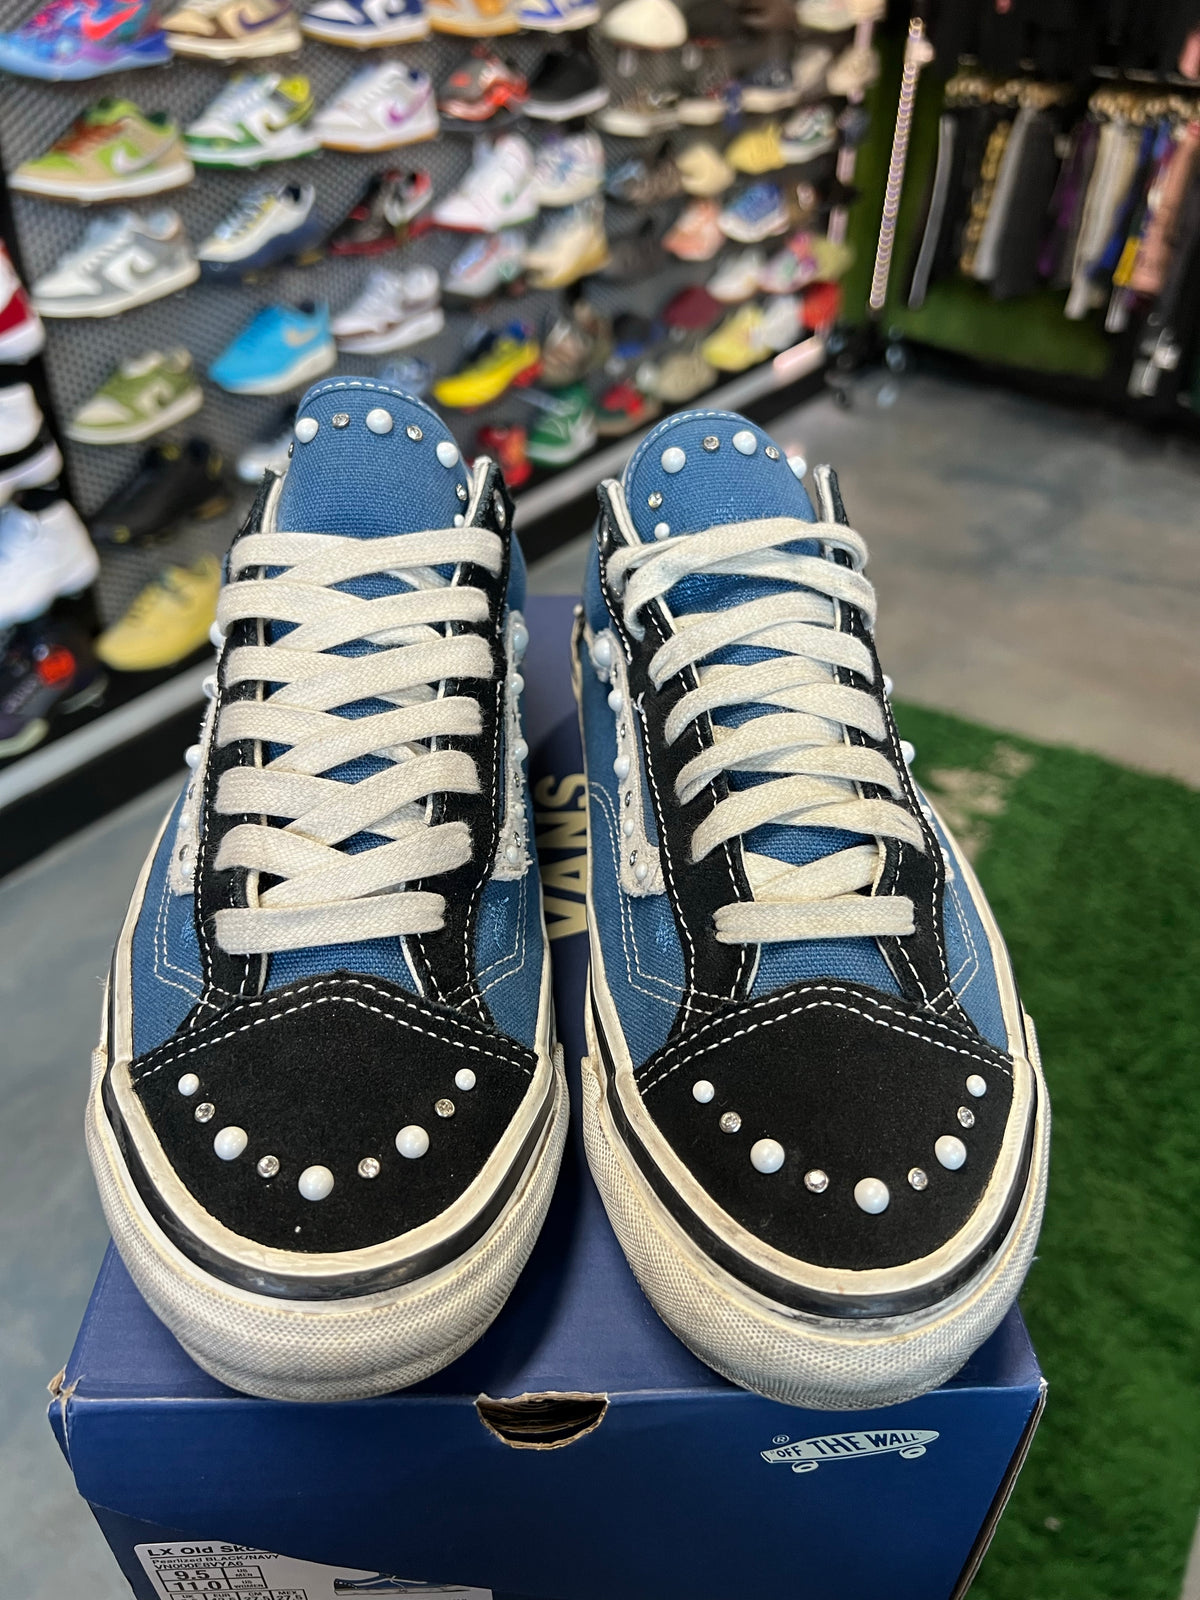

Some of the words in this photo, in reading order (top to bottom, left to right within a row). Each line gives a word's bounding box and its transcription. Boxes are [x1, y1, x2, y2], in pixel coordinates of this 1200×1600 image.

[534, 773, 587, 939] VANS
[806, 1435, 867, 1455] THE
[147, 1548, 174, 1556] LX
[180, 1546, 214, 1555] Old
[220, 1545, 257, 1553] Sko
[205, 1554, 279, 1562] BLACK/NAVY
[174, 1570, 210, 1580] 9.5
[174, 1581, 222, 1591] 11.0
